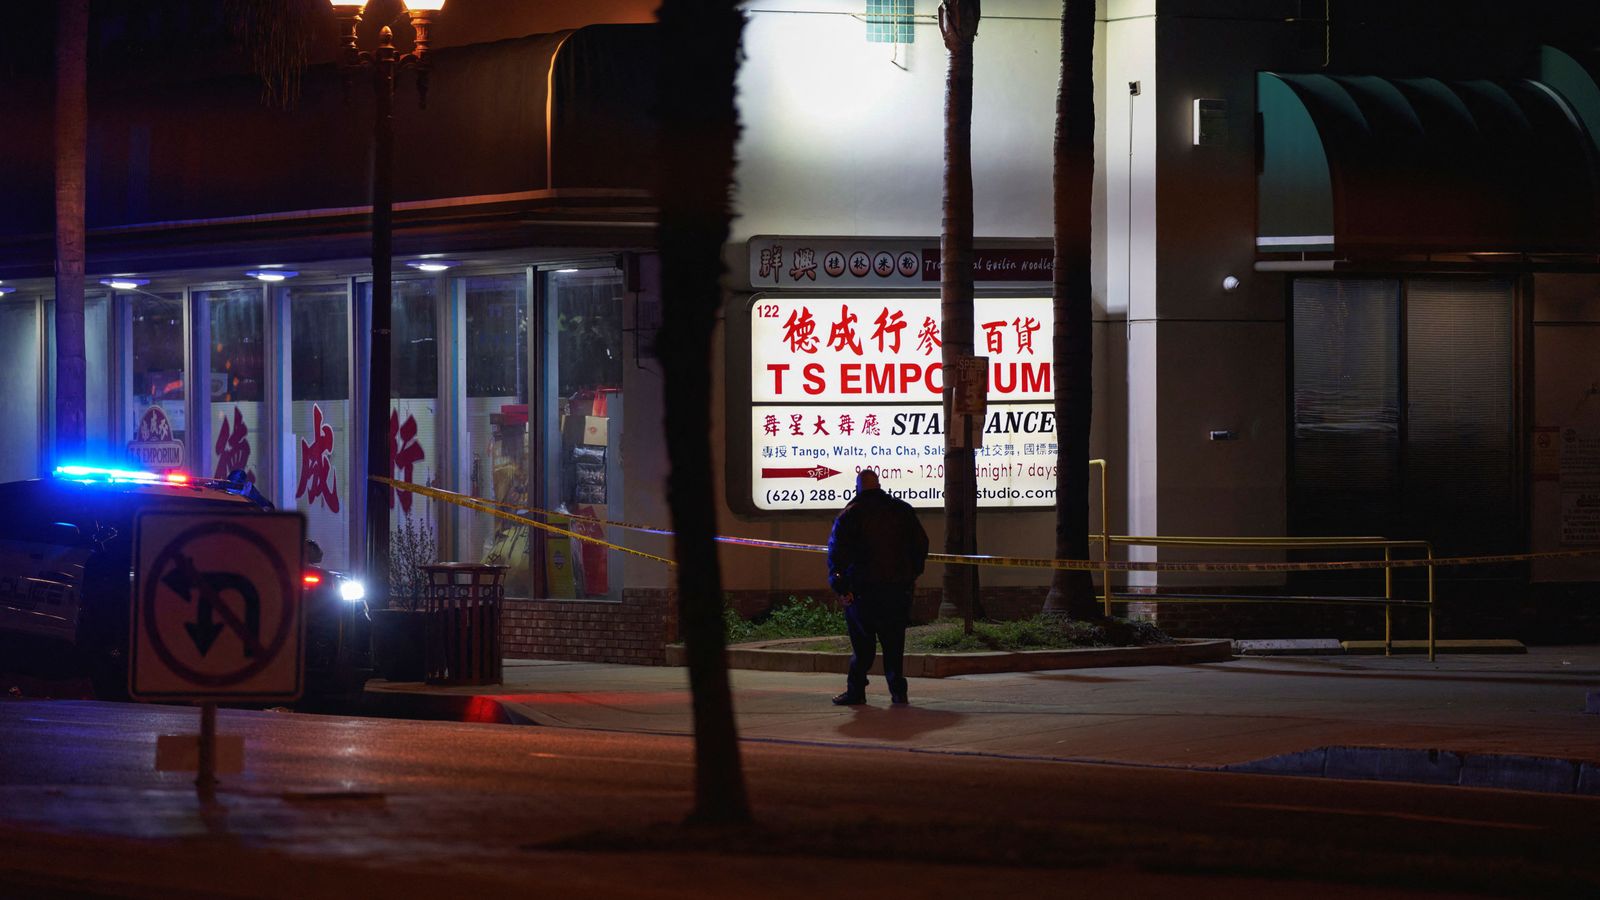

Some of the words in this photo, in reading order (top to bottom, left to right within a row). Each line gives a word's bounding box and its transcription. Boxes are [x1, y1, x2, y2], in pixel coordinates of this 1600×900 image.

[986, 258, 1017, 271] Guilin
[756, 305, 780, 318] 122
[767, 364, 790, 395] T
[802, 363, 826, 395] S
[841, 363, 1051, 395] EMPOUM
[891, 411, 945, 436] STA
[983, 411, 1056, 436] ANCE
[142, 447, 181, 465] EMPORIUM
[791, 446, 830, 459] Tango,
[833, 446, 867, 458] Waltz,
[871, 445, 893, 456] Cha
[895, 445, 921, 458] Cha,
[924, 445, 946, 456] Sals
[920, 463, 945, 479] 12:0
[974, 461, 1013, 482] dnight
[1017, 463, 1024, 478] 7
[1028, 462, 1059, 481] days
[765, 489, 805, 505] (626)
